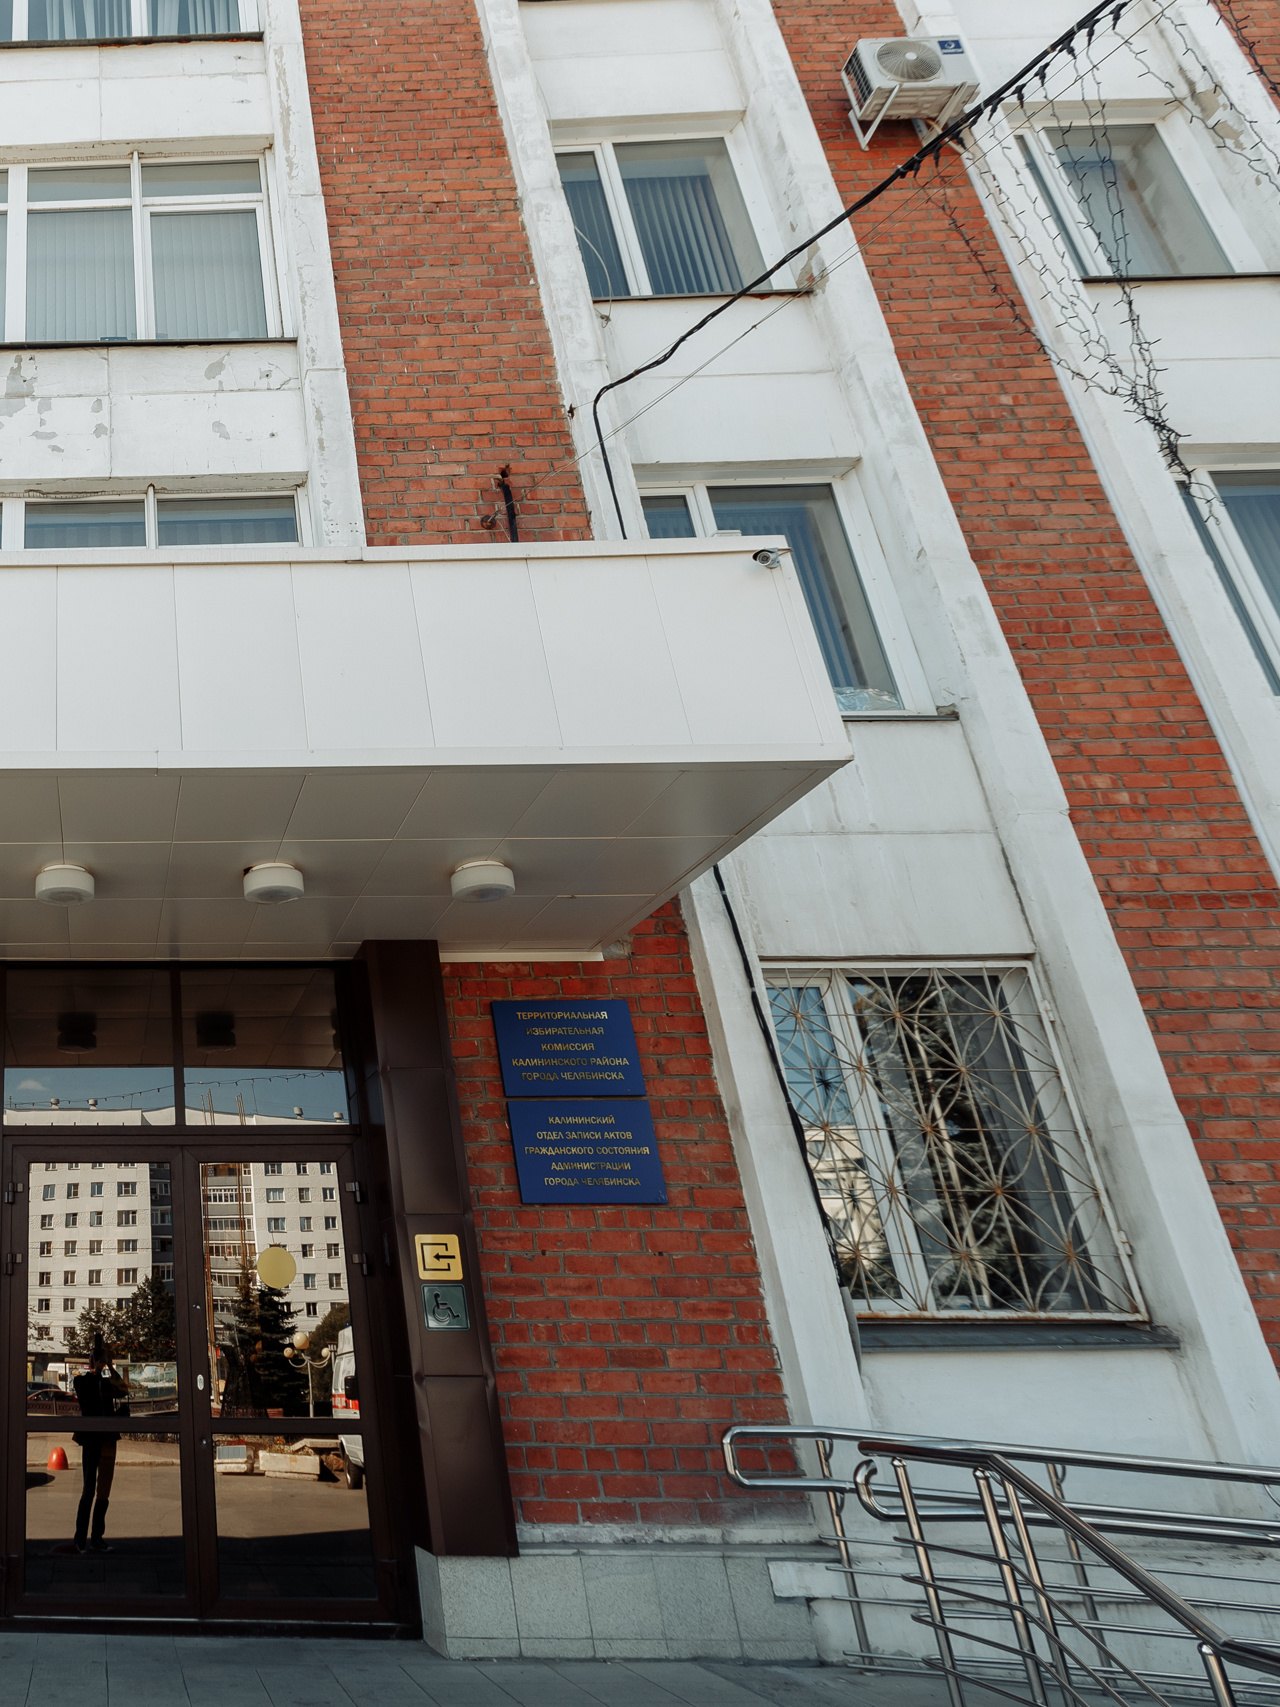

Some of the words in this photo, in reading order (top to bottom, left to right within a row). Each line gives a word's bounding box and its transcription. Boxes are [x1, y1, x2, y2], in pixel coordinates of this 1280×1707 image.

[516, 1011, 608, 1020] ТЕРРИТОРИАЛЬНАЯ
[526, 1027, 604, 1035] ИЗБИРАТЕЛЬНАЯ
[541, 1043, 594, 1051] КОМИССИЯ
[512, 1058, 588, 1066] КАЛИНИНСКОГО
[590, 1056, 629, 1066] РАЙОНА
[522, 1072, 559, 1081] ГОРОДА
[561, 1072, 624, 1080] ЧЕЛЯБИНСКА
[548, 1115, 615, 1124] КАЛИНИНСКИЙ
[536, 1132, 564, 1140] ОТДЕЛ
[565, 1132, 601, 1140] ЗАПИСИ
[604, 1132, 632, 1140] АКТОВ
[524, 1147, 594, 1155] ГРАЖДАНСКОГО
[596, 1147, 649, 1155] СОСТОЯНИЯ
[551, 1162, 631, 1171] АДМИНИСТРАЦИИ
[544, 1178, 579, 1187] ГОРОДА
[581, 1177, 641, 1186] ЧЕЛЯБИНСКА
